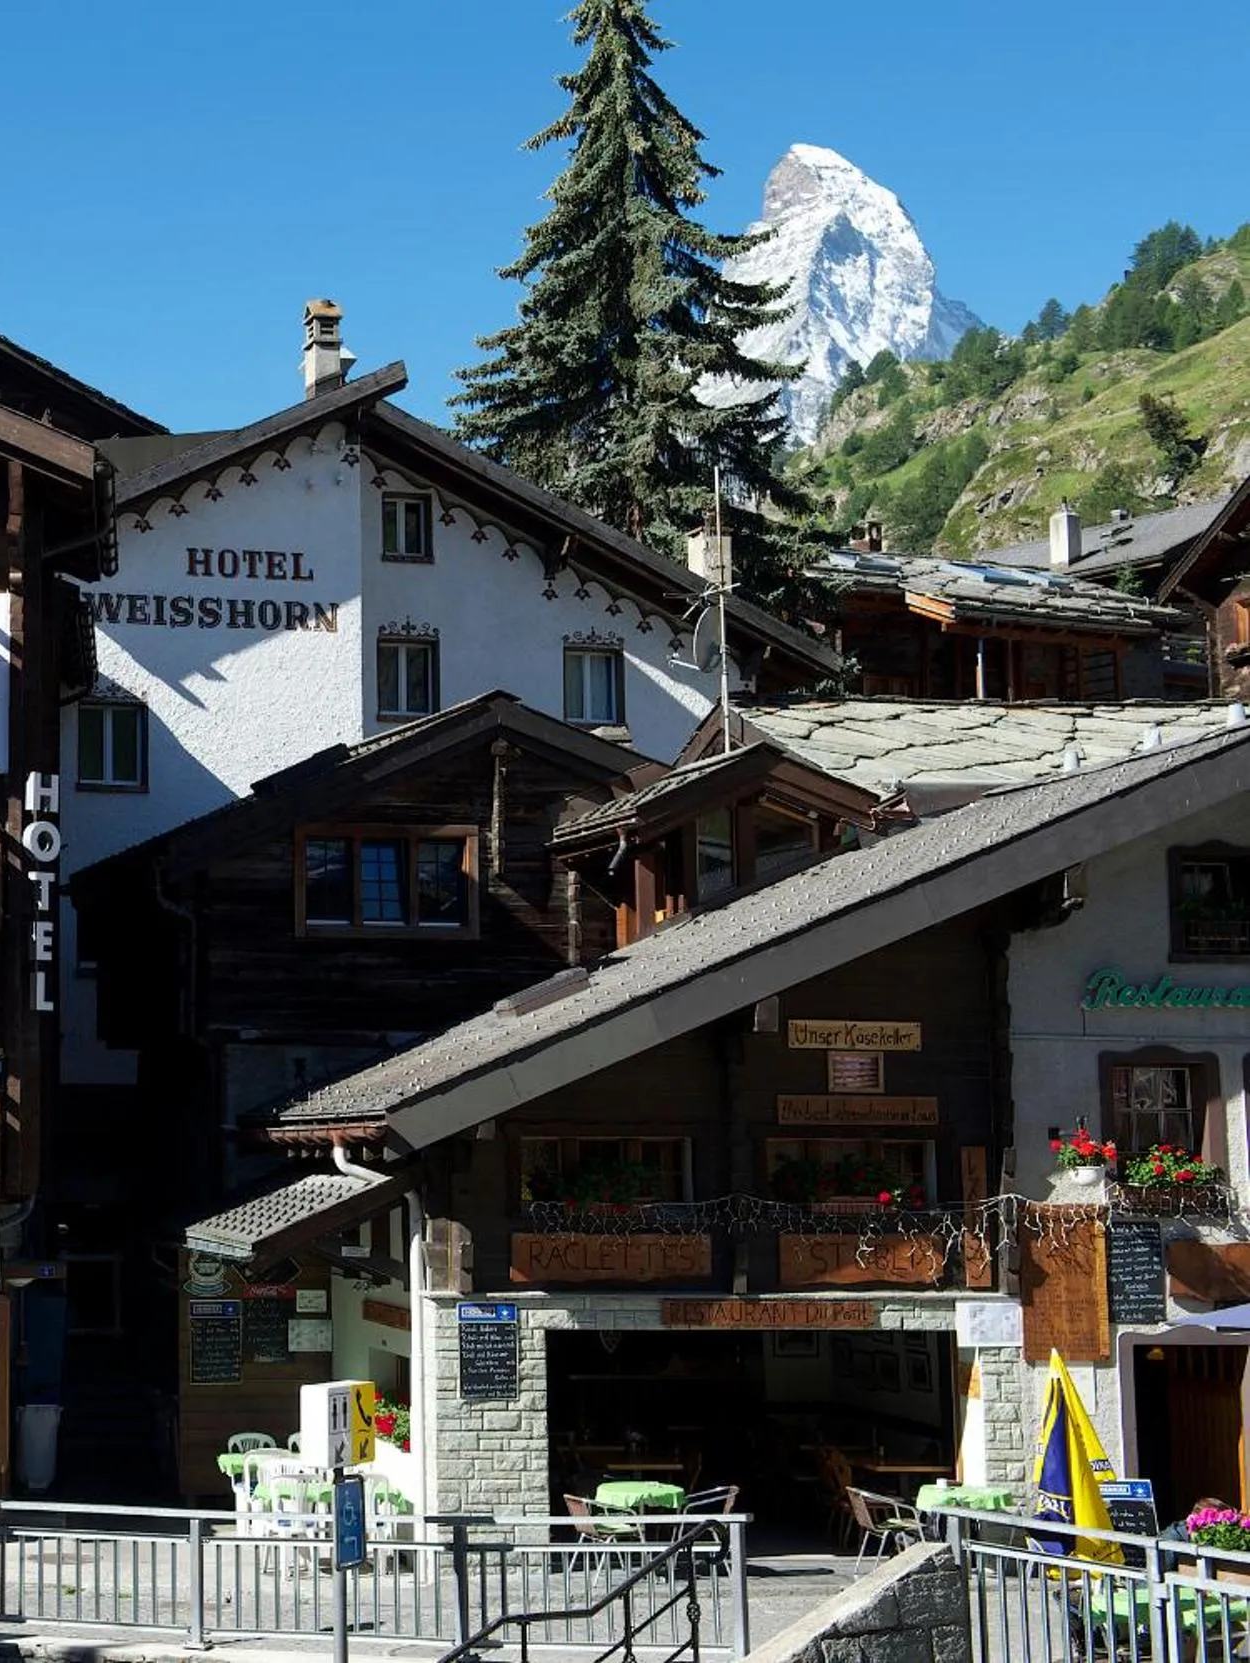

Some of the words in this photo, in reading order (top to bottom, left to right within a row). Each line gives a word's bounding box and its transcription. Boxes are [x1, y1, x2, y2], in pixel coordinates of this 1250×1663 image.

[186, 547, 314, 581] HOTEL
[82, 592, 338, 633] WEISSHORN
[23, 771, 61, 1011] HOTEL
[793, 1022, 842, 1046] Unser
[669, 1301, 798, 1324] RESTAURANT
